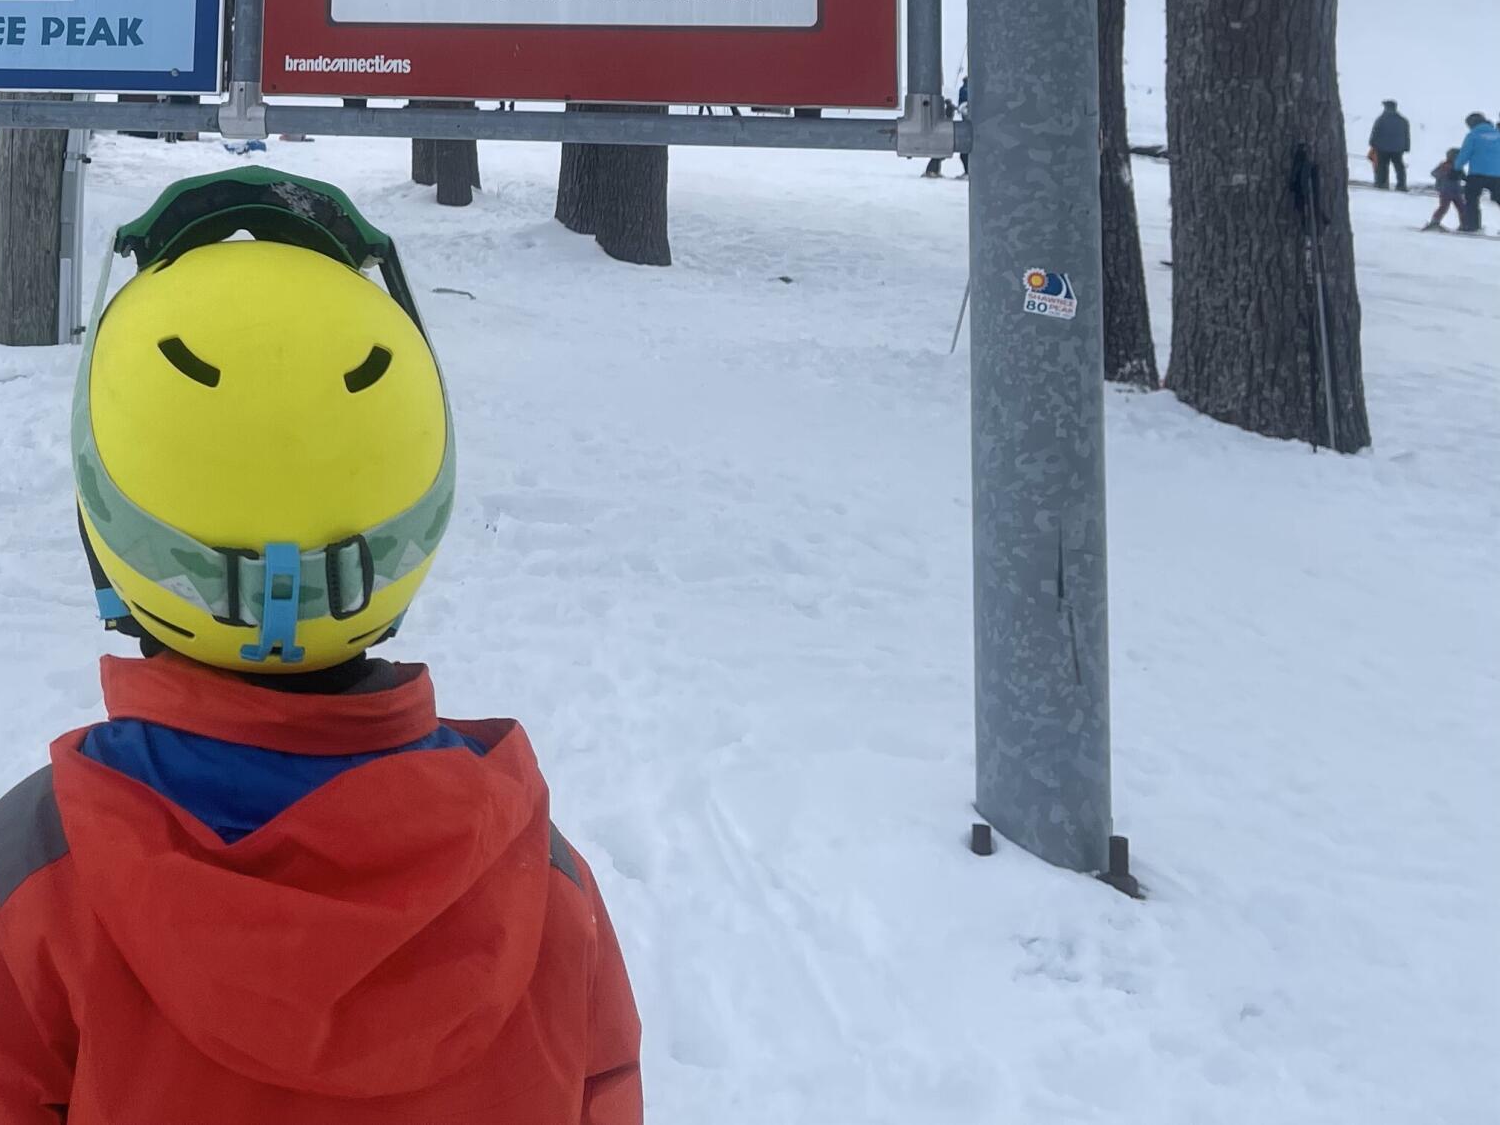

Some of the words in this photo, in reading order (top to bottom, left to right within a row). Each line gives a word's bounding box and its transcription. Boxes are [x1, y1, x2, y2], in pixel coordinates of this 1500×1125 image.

[41, 16, 144, 46] PEAK
[285, 55, 411, 75] brandconnections
[1026, 300, 1047, 312] 80
